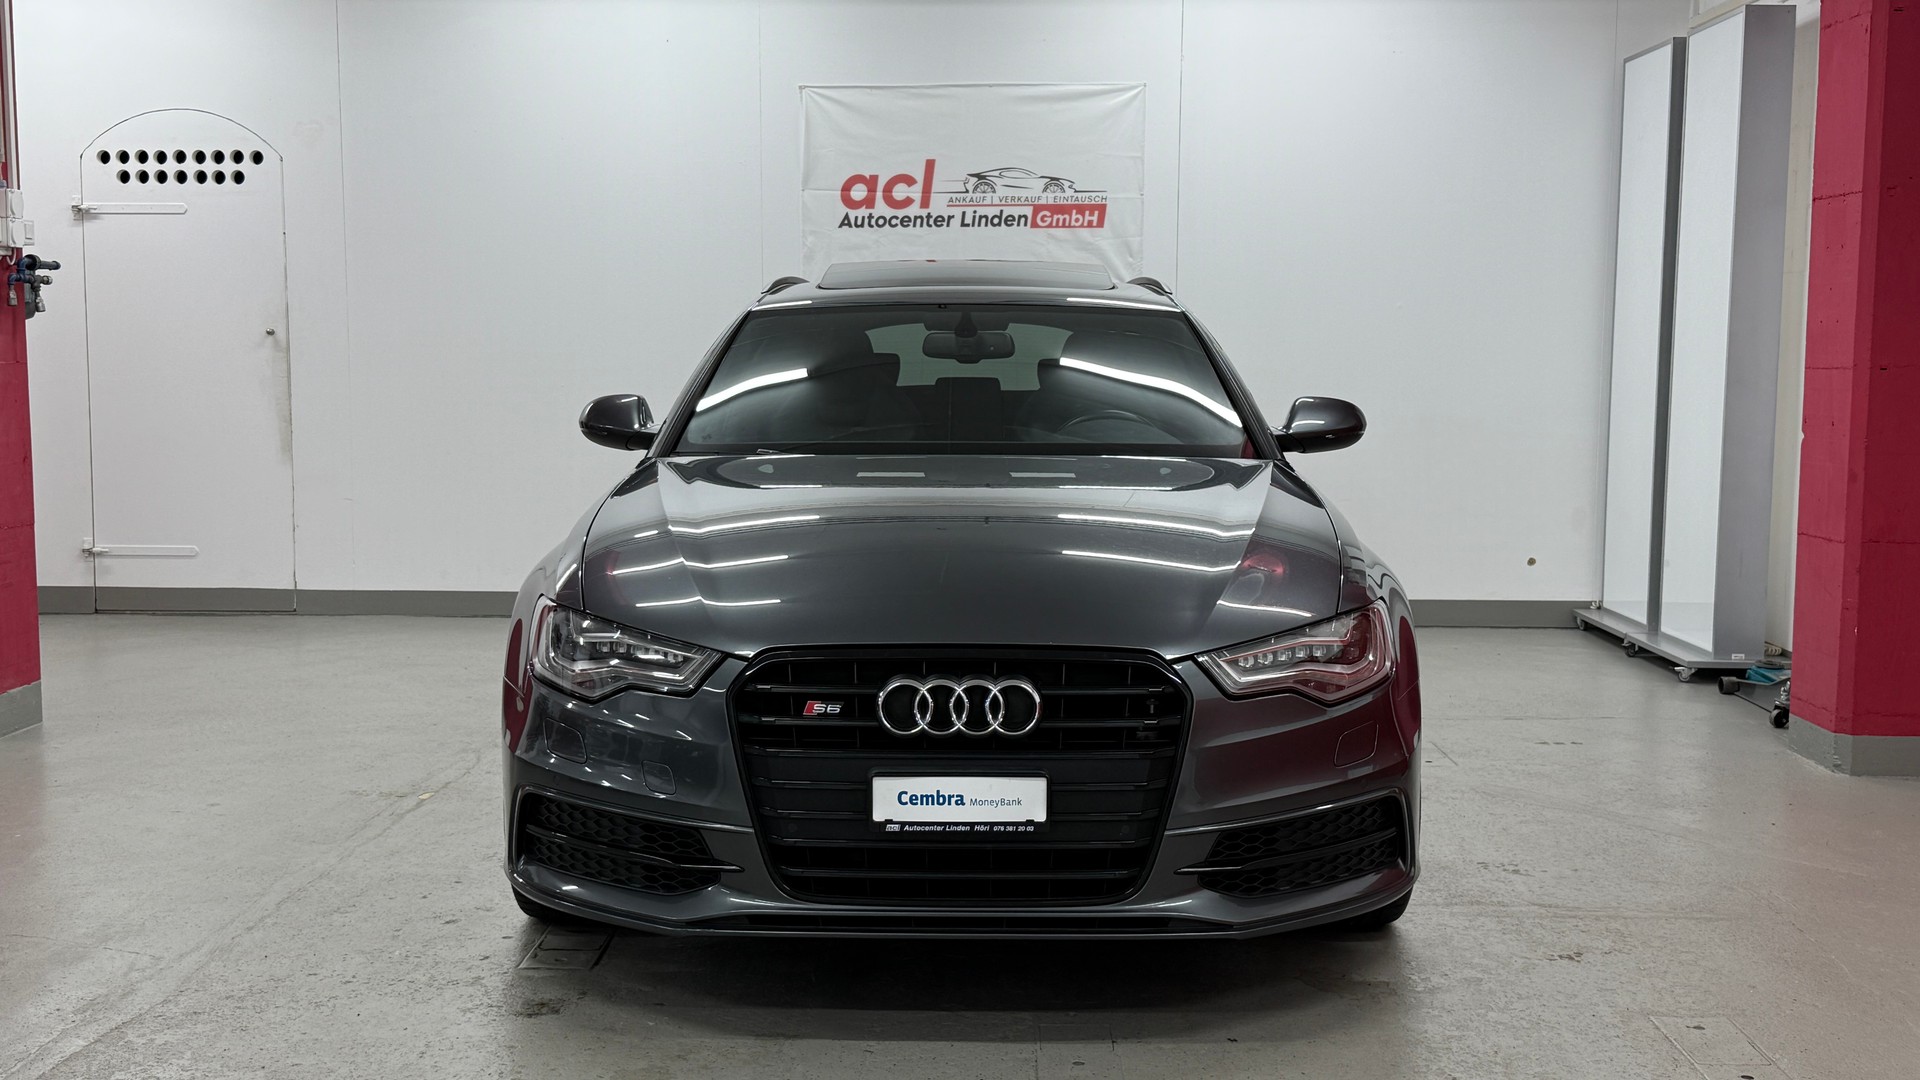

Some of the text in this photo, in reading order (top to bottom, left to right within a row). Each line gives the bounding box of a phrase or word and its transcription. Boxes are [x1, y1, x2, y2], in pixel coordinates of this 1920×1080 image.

[840, 158, 936, 211] acl
[947, 195, 988, 204] ANKAUF
[998, 195, 1043, 204] VERKAUF
[1053, 194, 1108, 204] EINTAUSCH
[838, 209, 1099, 229] Autocenter Linden GmbH
[812, 703, 842, 714] S6
[897, 789, 1023, 809] Cembra MoneyBank
